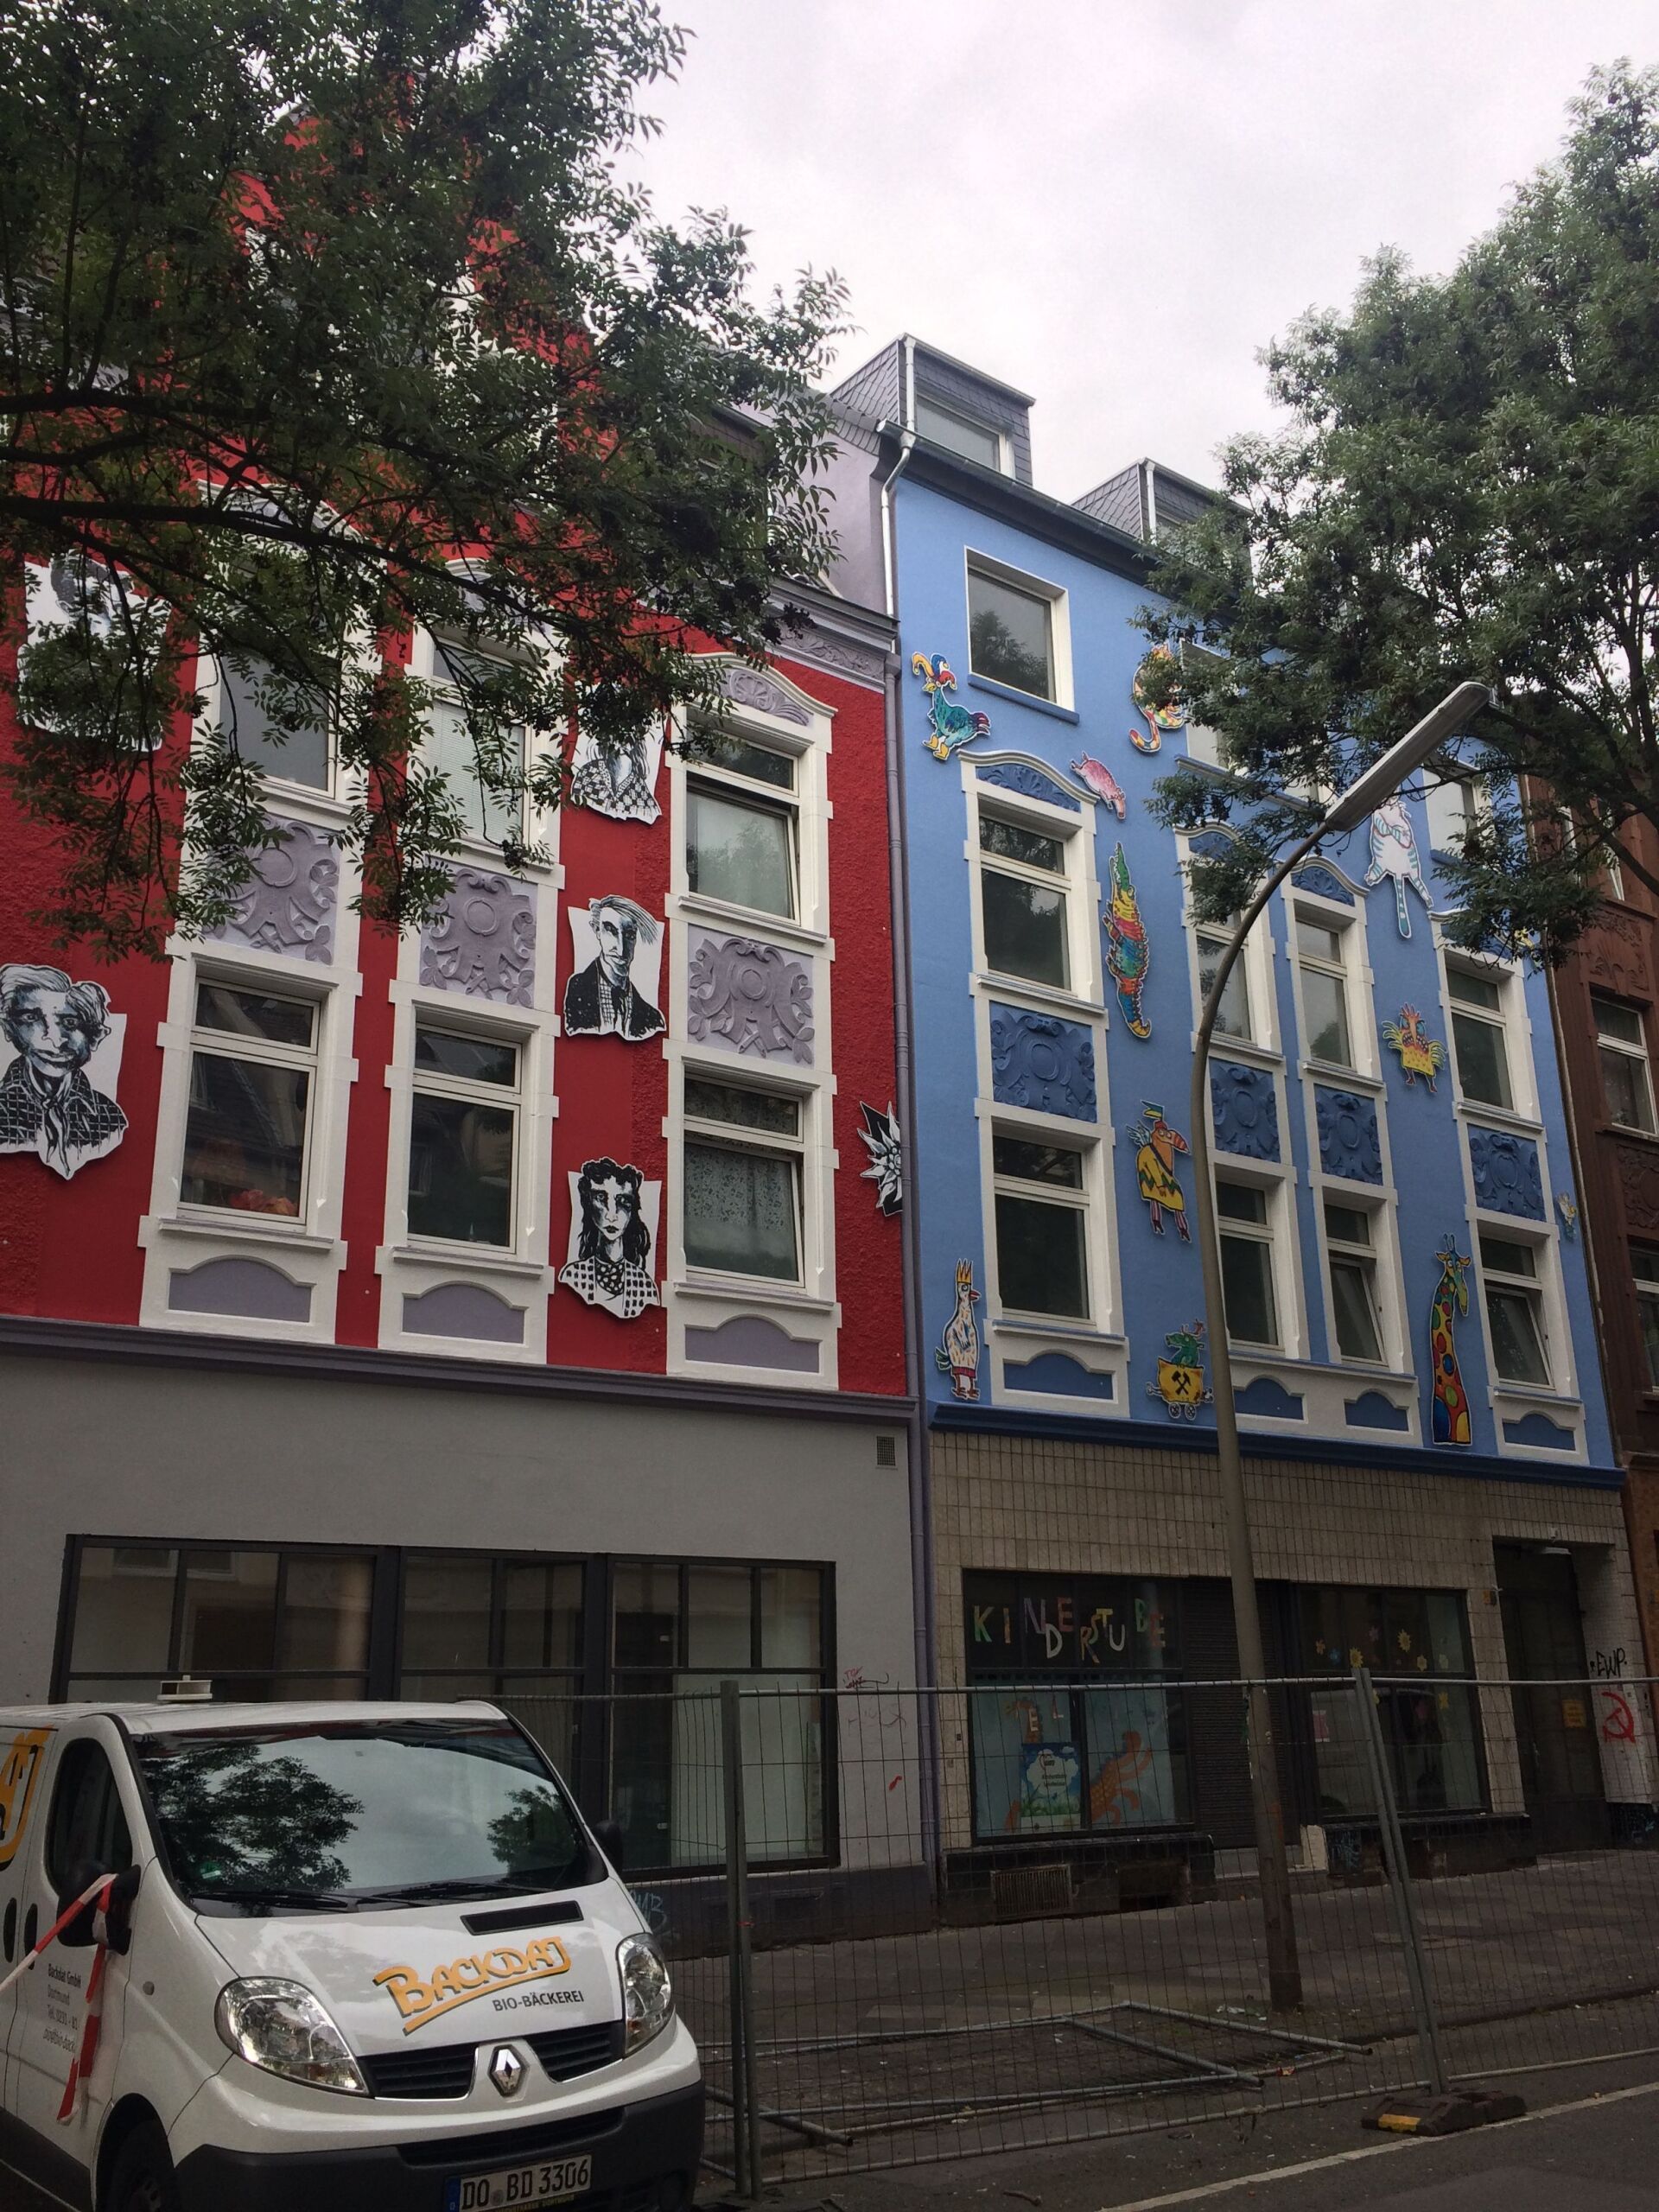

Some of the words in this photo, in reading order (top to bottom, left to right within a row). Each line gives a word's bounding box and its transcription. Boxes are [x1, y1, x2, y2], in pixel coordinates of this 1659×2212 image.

[372, 1936, 572, 2021] BACKDAT
[492, 1989, 585, 2012] BIO-BÄCKEREI
[461, 2179, 490, 2210] DO
[506, 2170, 533, 2202] BD
[539, 2159, 588, 2194] 3306
